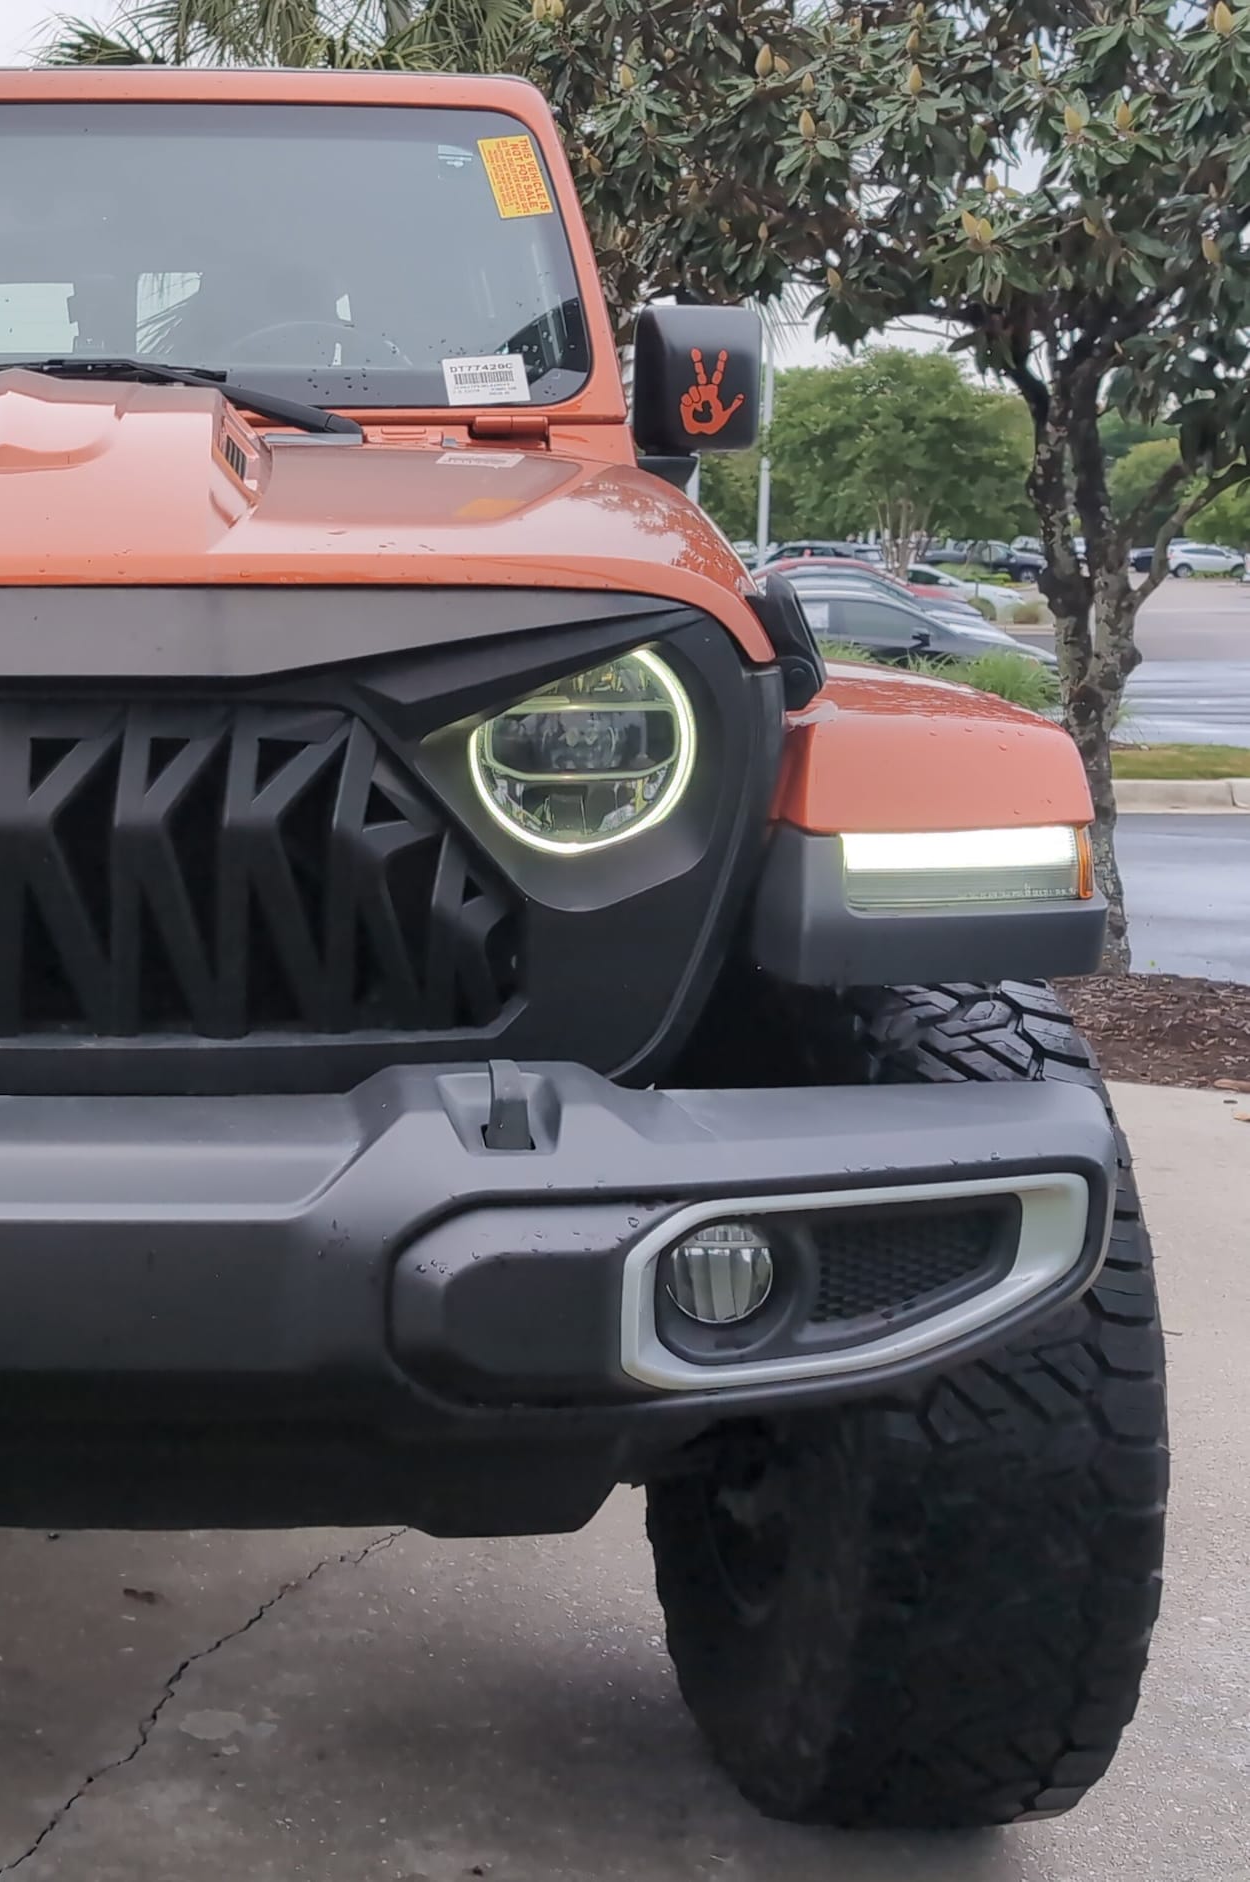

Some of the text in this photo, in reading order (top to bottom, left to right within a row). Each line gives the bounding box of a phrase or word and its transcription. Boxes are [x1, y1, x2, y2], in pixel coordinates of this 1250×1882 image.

[509, 143, 538, 207] NOT FOR SALE
[518, 138, 532, 158] THIS
[525, 160, 546, 199] VEHICLE
